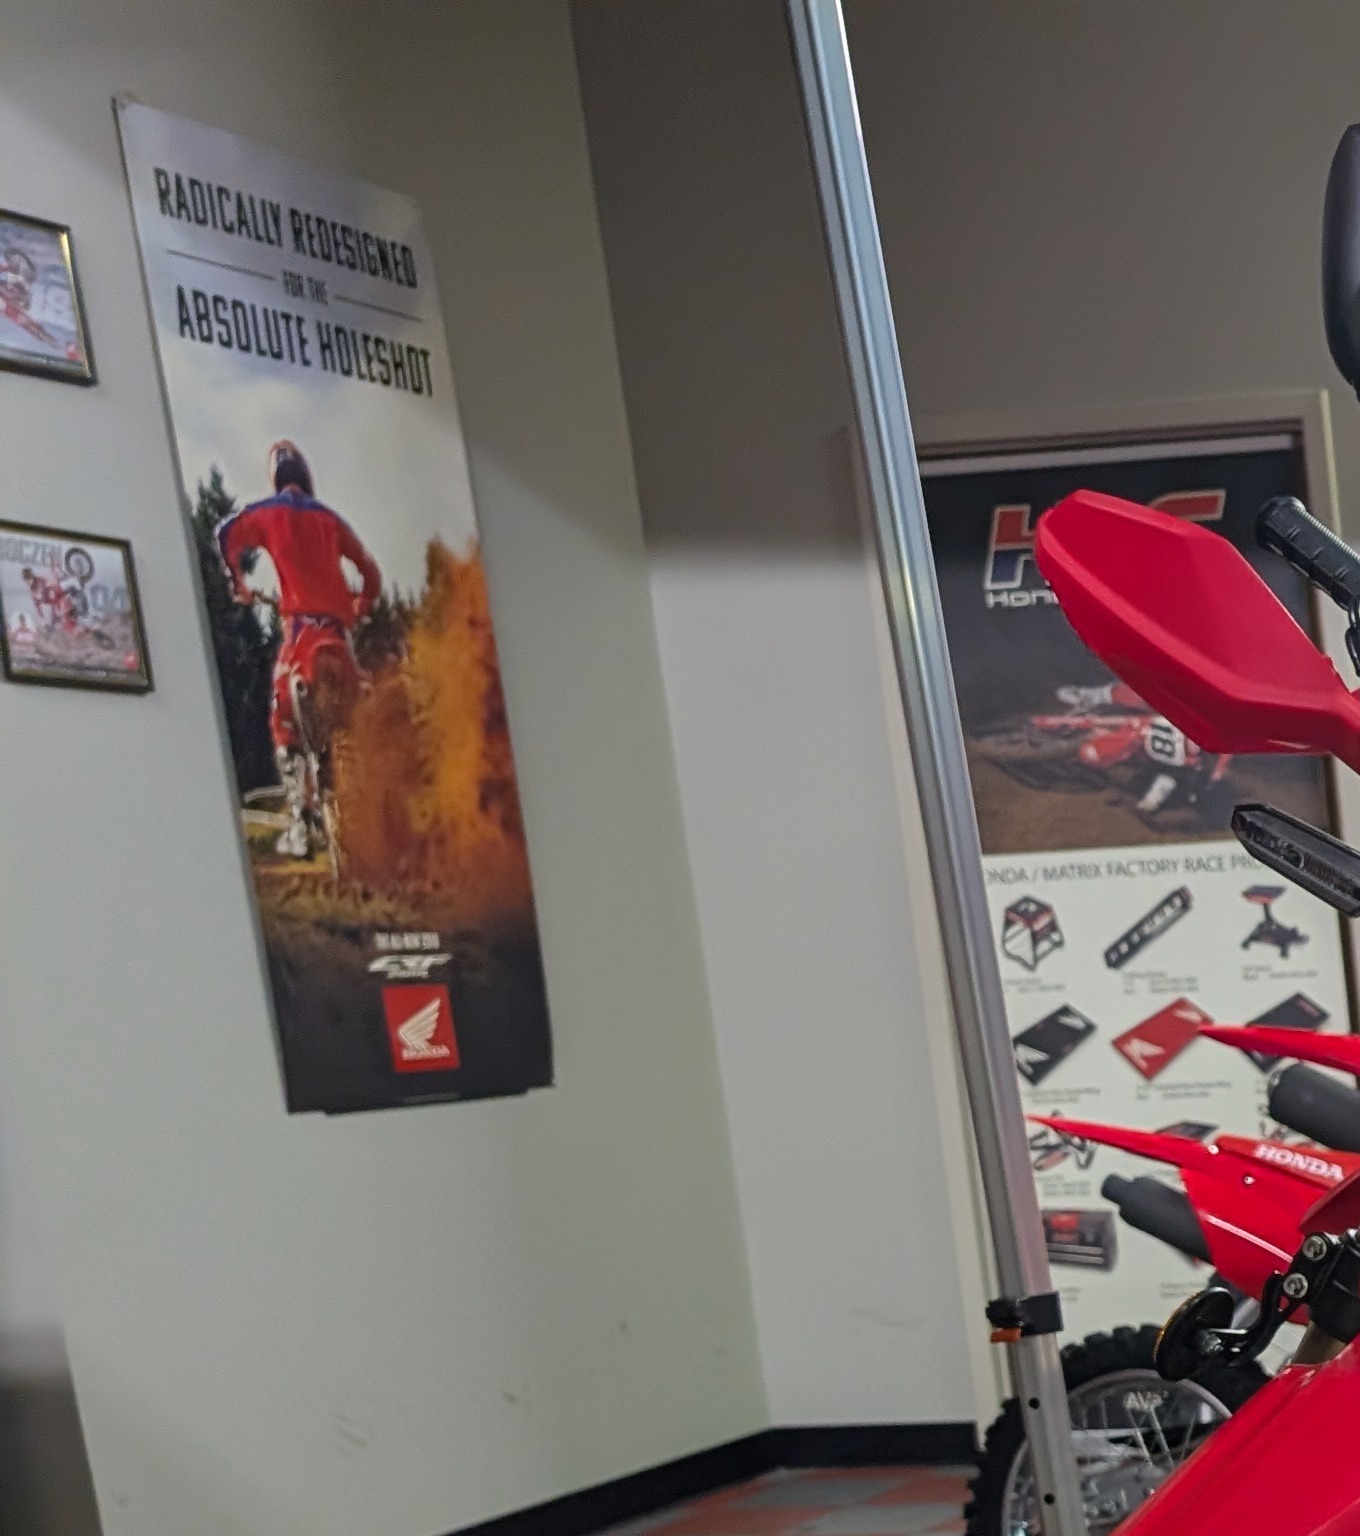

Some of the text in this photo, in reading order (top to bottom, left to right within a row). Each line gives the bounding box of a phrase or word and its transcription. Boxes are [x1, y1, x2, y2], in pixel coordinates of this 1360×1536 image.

[154, 167, 417, 289] RADICALLY REDESIGNED
[177, 284, 433, 397] ABSOLUTE HOLESHOT
[985, 865, 1030, 885] NDA
[1042, 861, 1101, 881] MATRIX
[1107, 858, 1179, 879] FACTORY
[1184, 855, 1224, 873] RACE
[1254, 1143, 1345, 1182] HONDA
